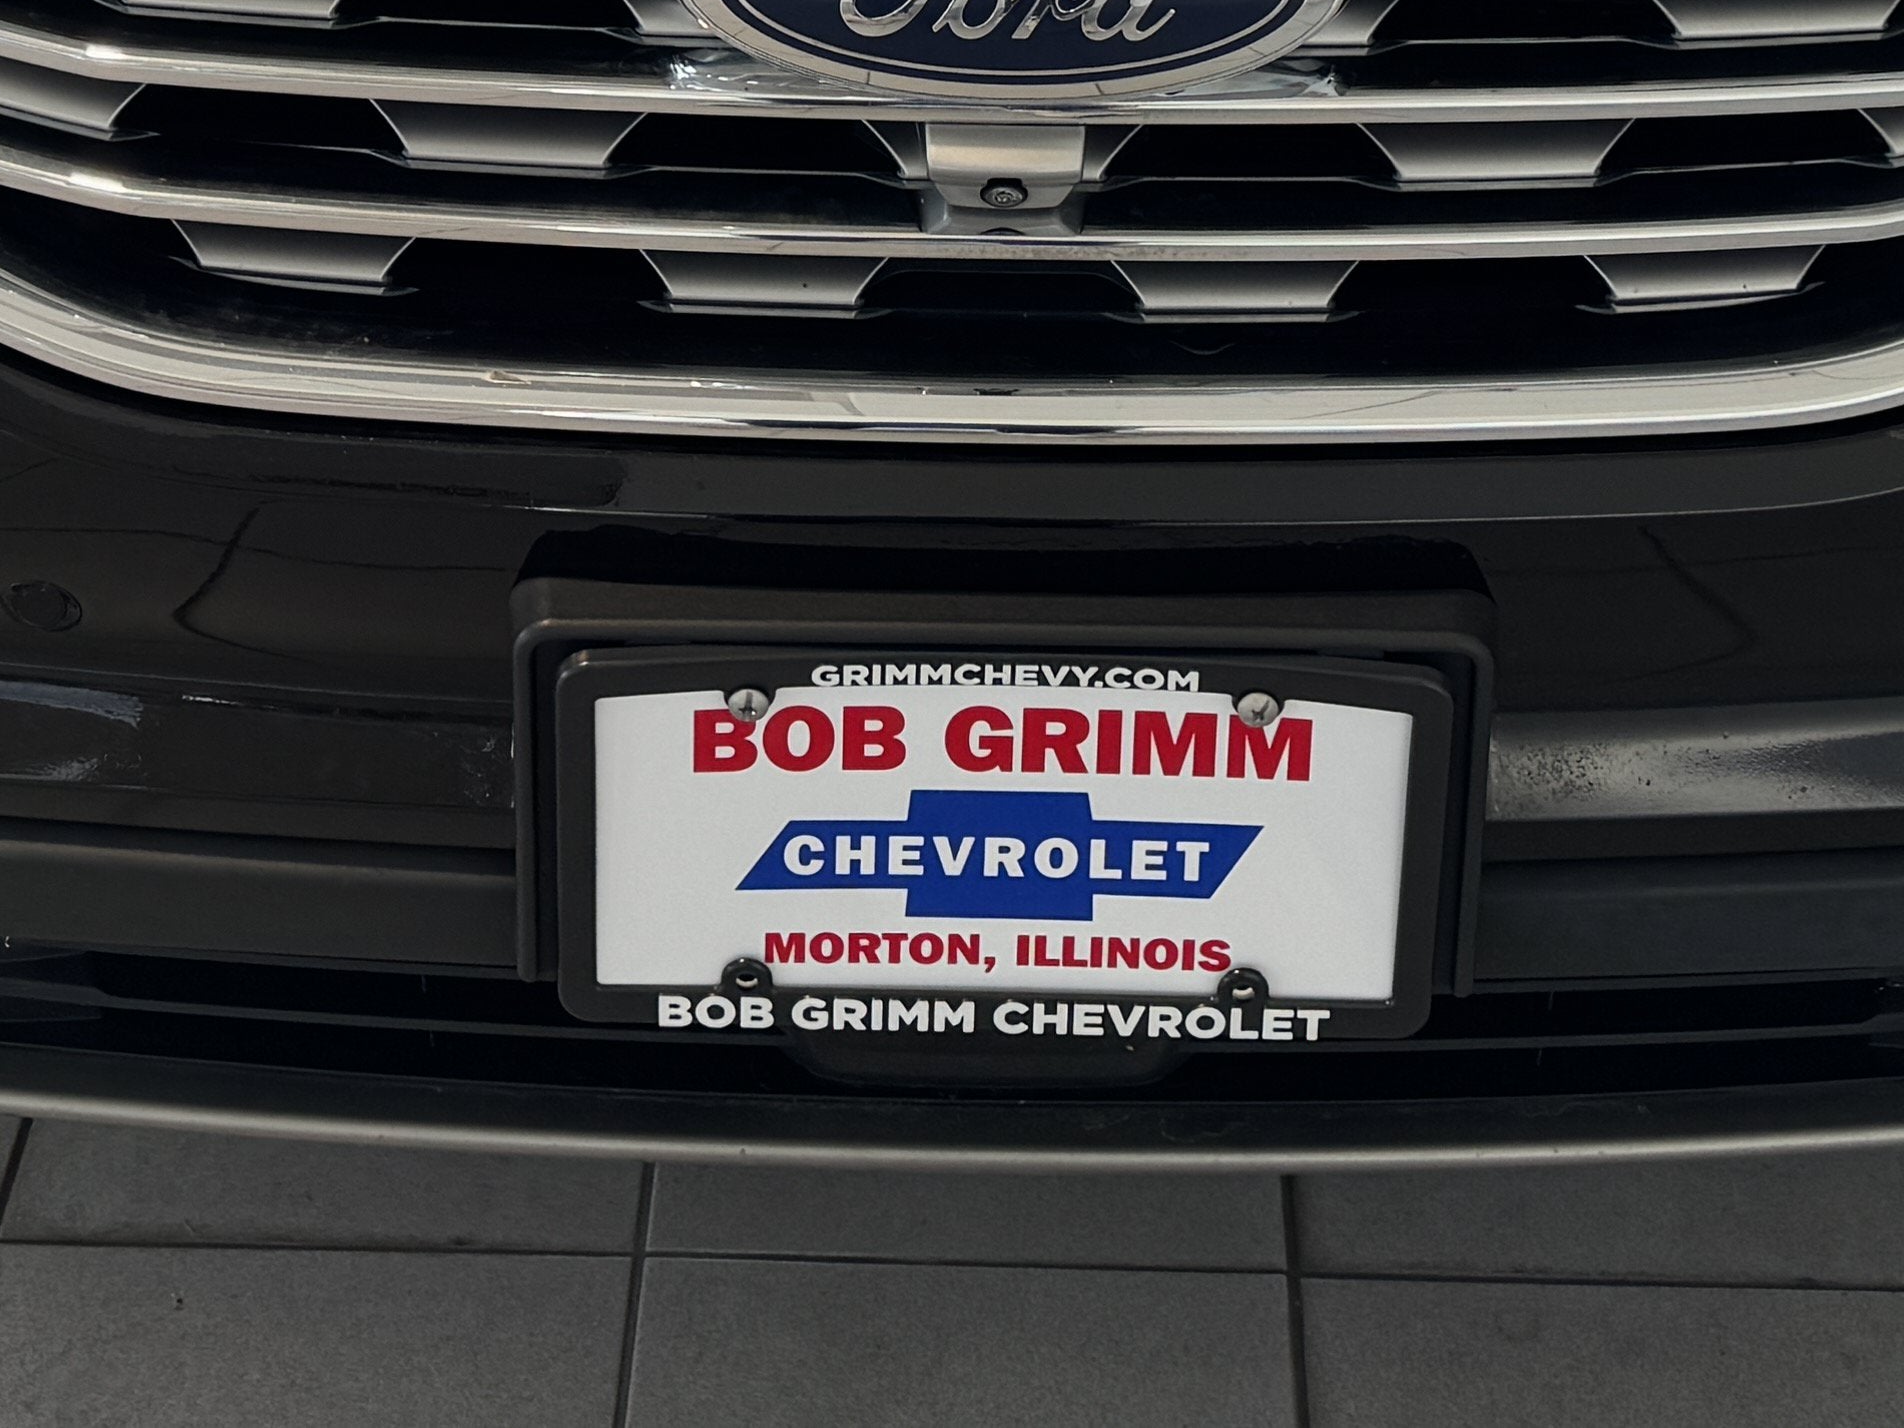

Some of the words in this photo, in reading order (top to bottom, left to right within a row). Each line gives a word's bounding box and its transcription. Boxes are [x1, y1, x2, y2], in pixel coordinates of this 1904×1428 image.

[810, 663, 1200, 692] GRIMMCHEVY.COM
[692, 705, 907, 773] BOB
[945, 705, 1313, 781] GRIMM
[783, 834, 1211, 882] CHEVROLET
[763, 931, 996, 973] MORTON,
[1015, 934, 1232, 972] ILLINOIS
[657, 995, 775, 1031] BOB
[791, 997, 976, 1034] GRIMM
[993, 1002, 1331, 1042] CHEVROLET
